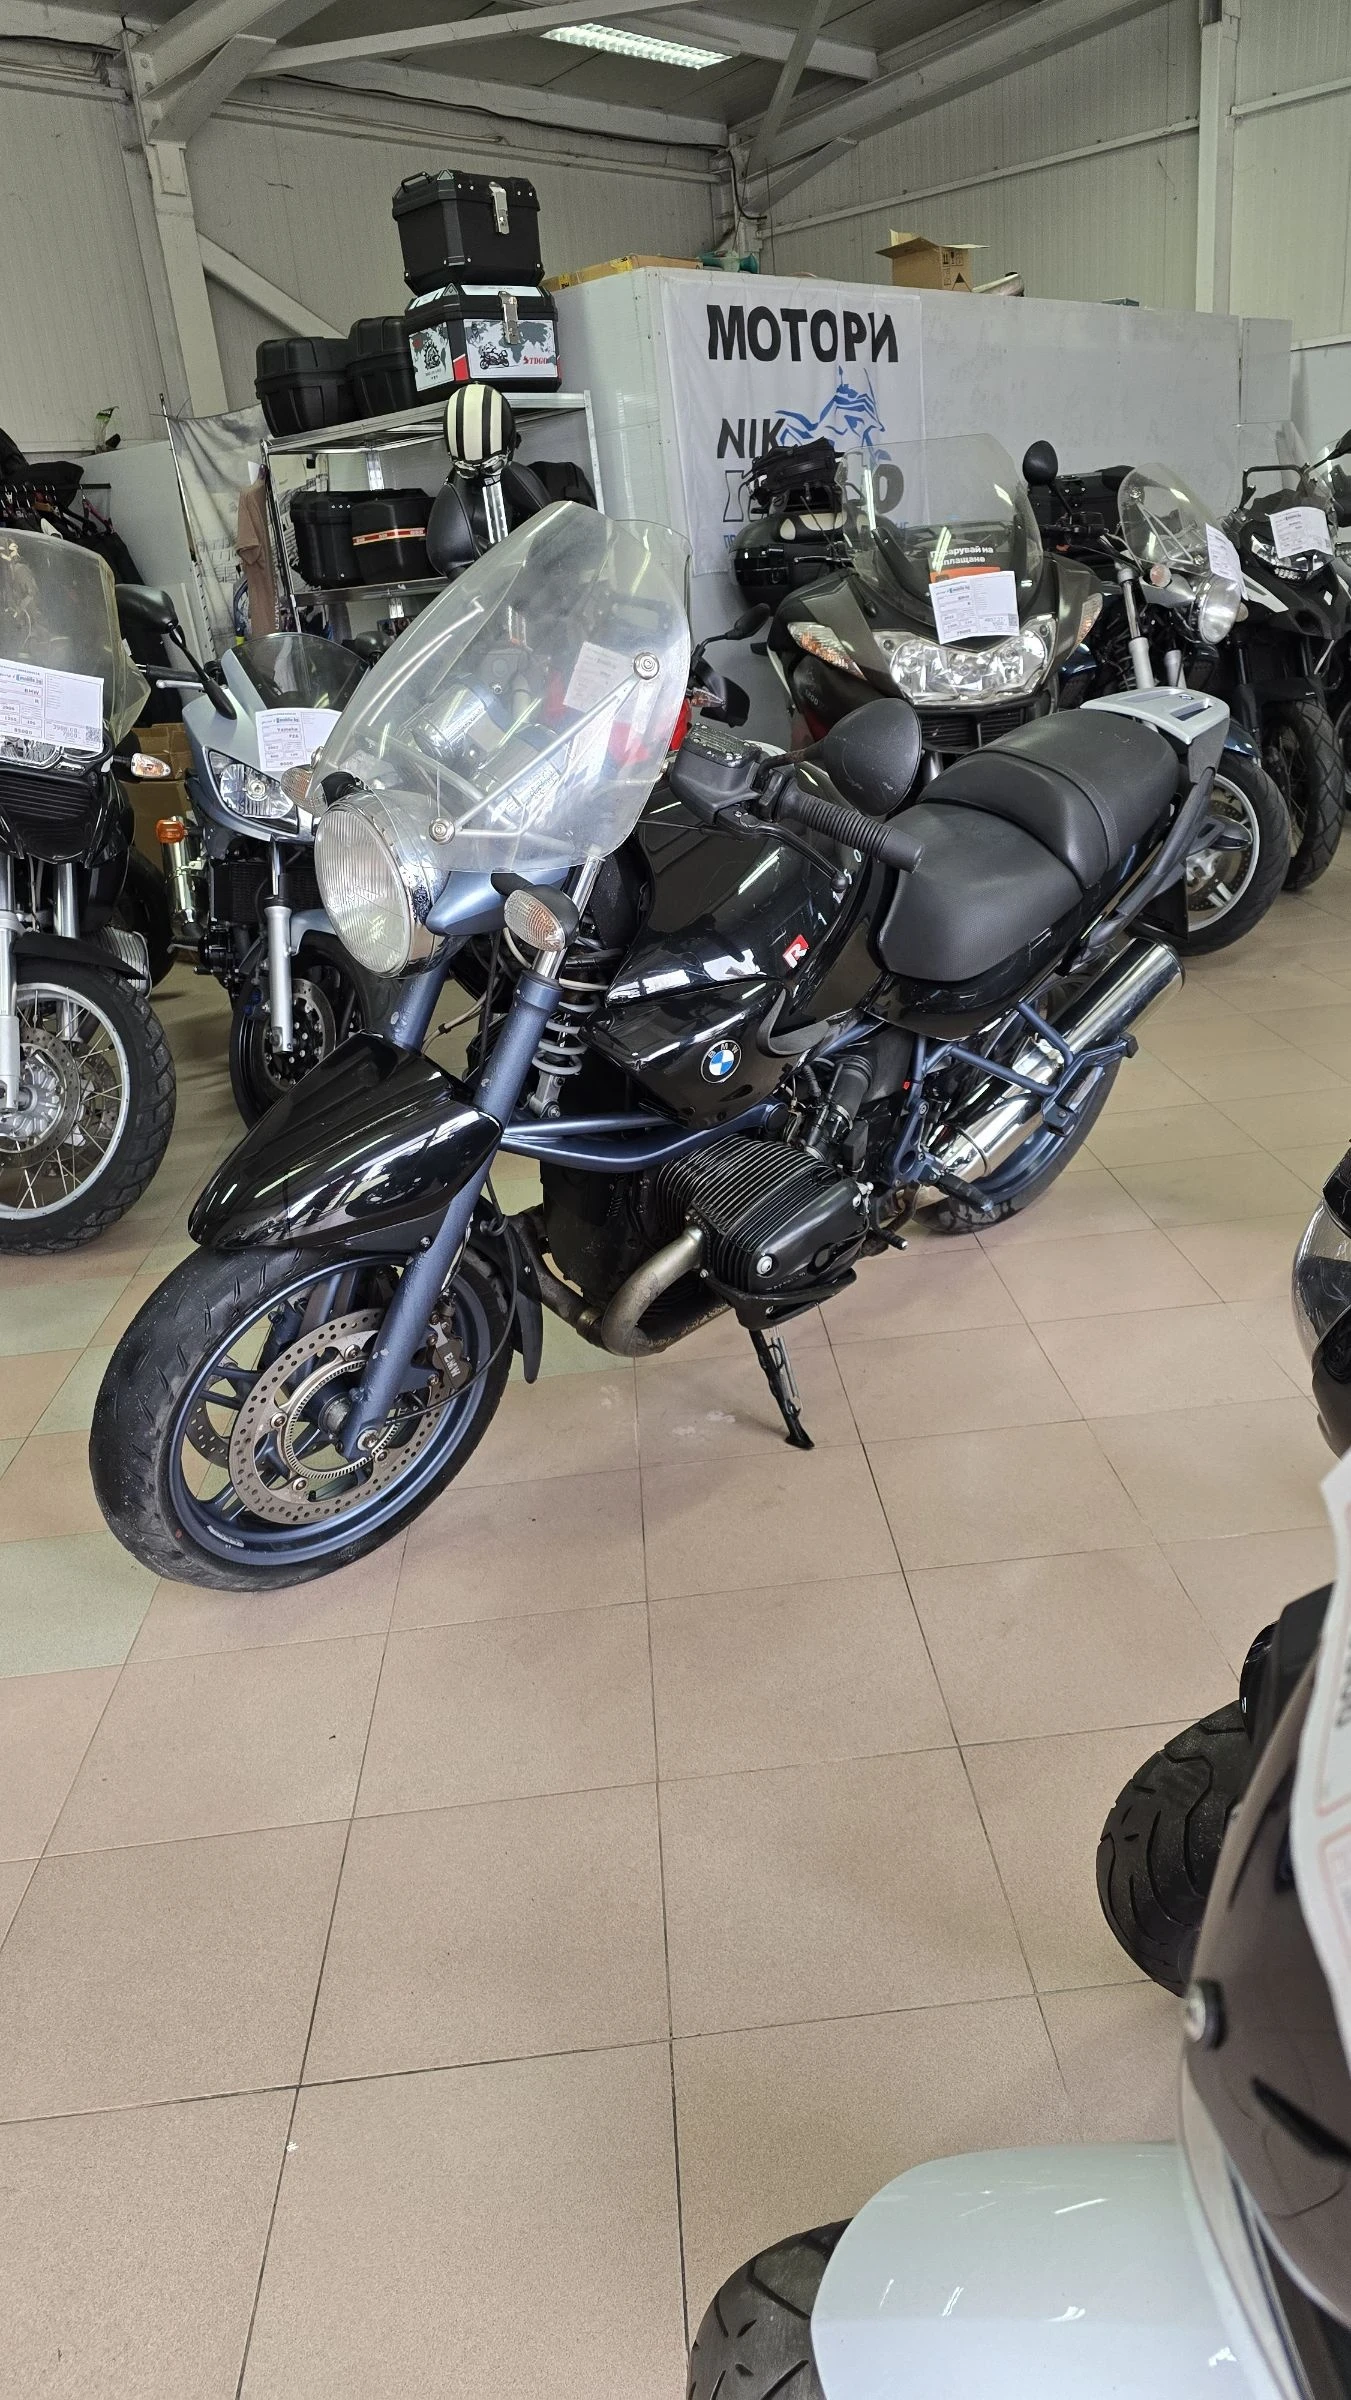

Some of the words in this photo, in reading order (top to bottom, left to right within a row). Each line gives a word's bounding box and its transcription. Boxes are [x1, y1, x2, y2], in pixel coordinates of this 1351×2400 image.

[707, 304, 898, 363] МОТОРИ
[783, 943, 809, 969] R
[707, 1043, 739, 1059] BMW
[444, 1352, 461, 1378] BMW
